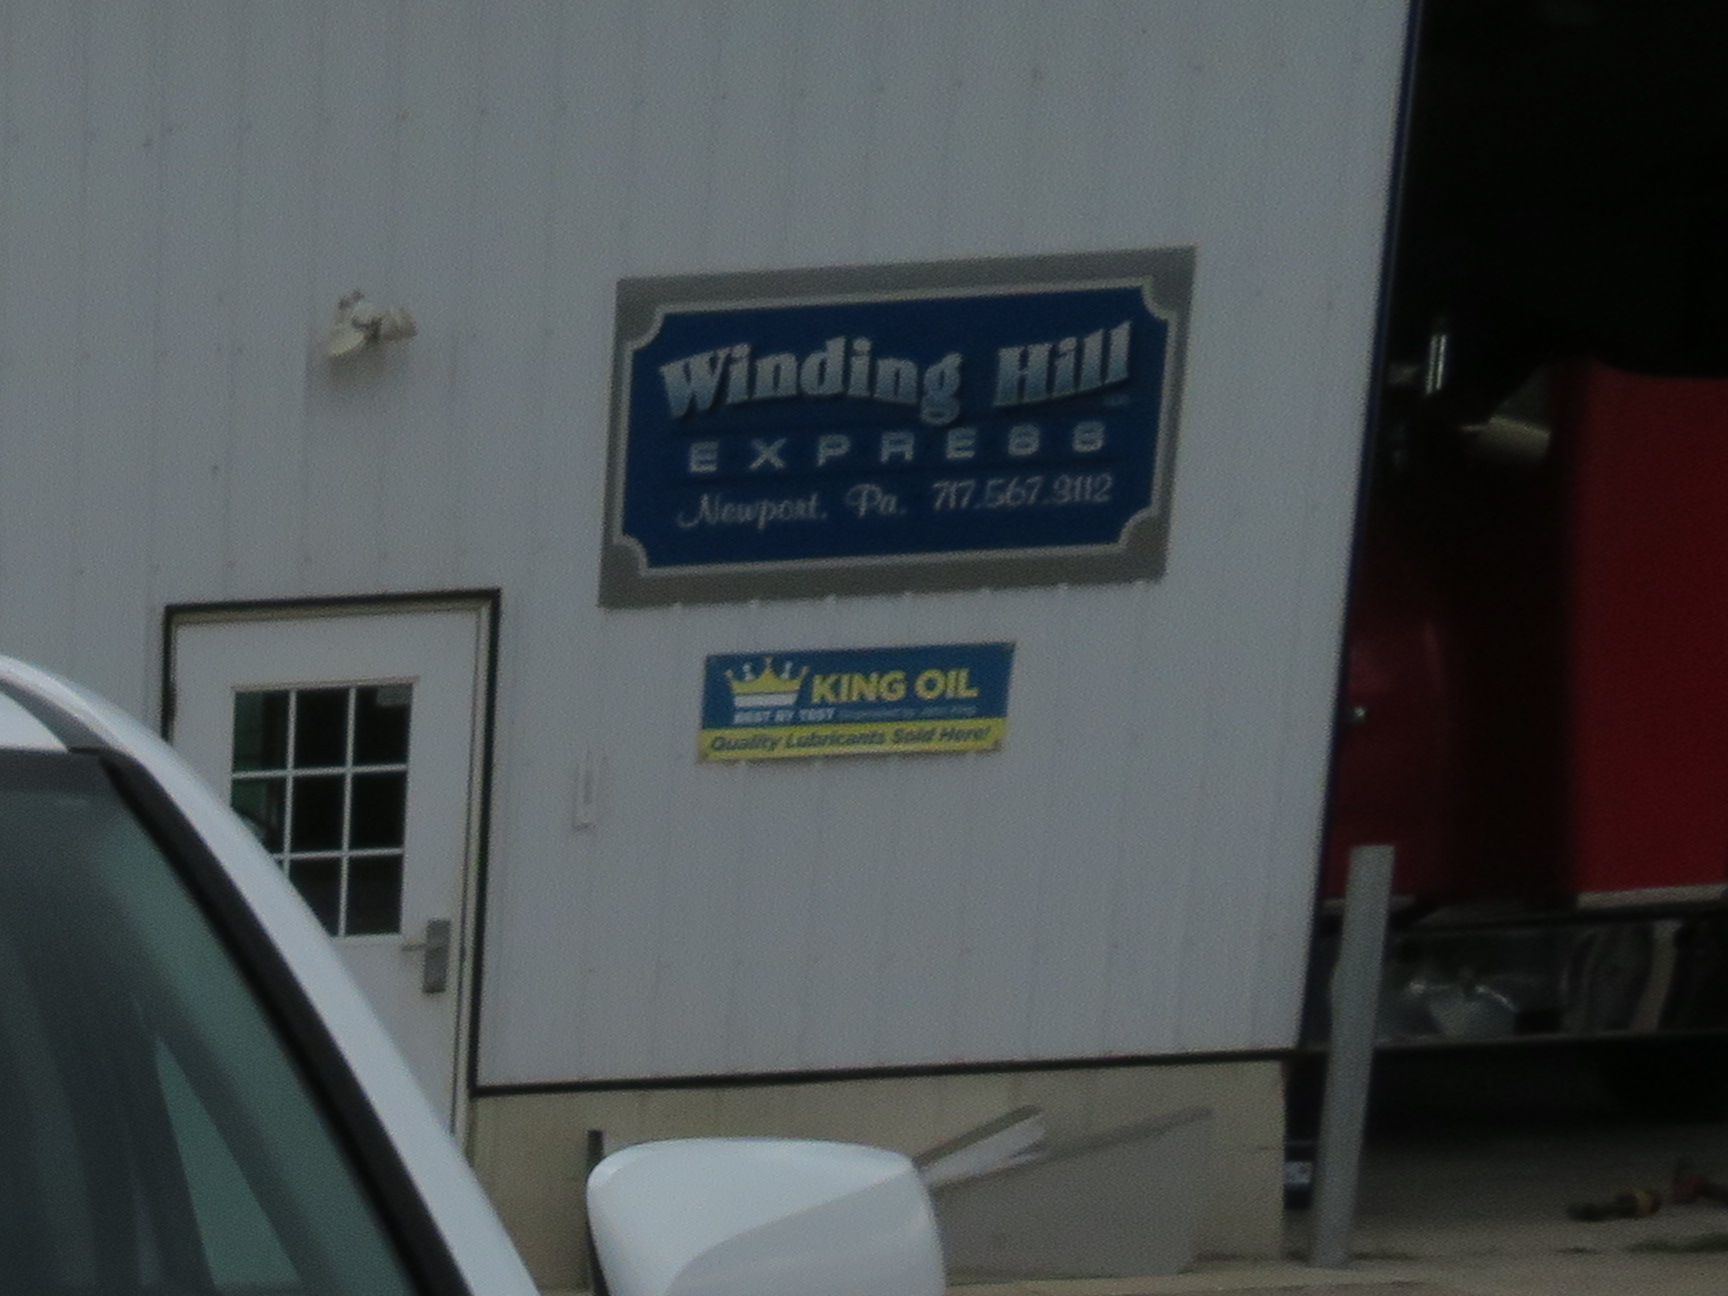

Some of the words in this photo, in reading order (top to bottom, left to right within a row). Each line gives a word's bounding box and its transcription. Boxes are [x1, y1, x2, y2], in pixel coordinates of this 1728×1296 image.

[659, 336, 963, 425] Winding
[992, 320, 1133, 407] Hill
[689, 419, 1106, 473] EXPRESS
[811, 671, 906, 704] KING
[915, 668, 980, 700] OIL
[711, 735, 783, 752] Quality
[785, 730, 887, 748] Lubricants
[891, 727, 936, 744] Sold
[937, 725, 993, 742] Here!
